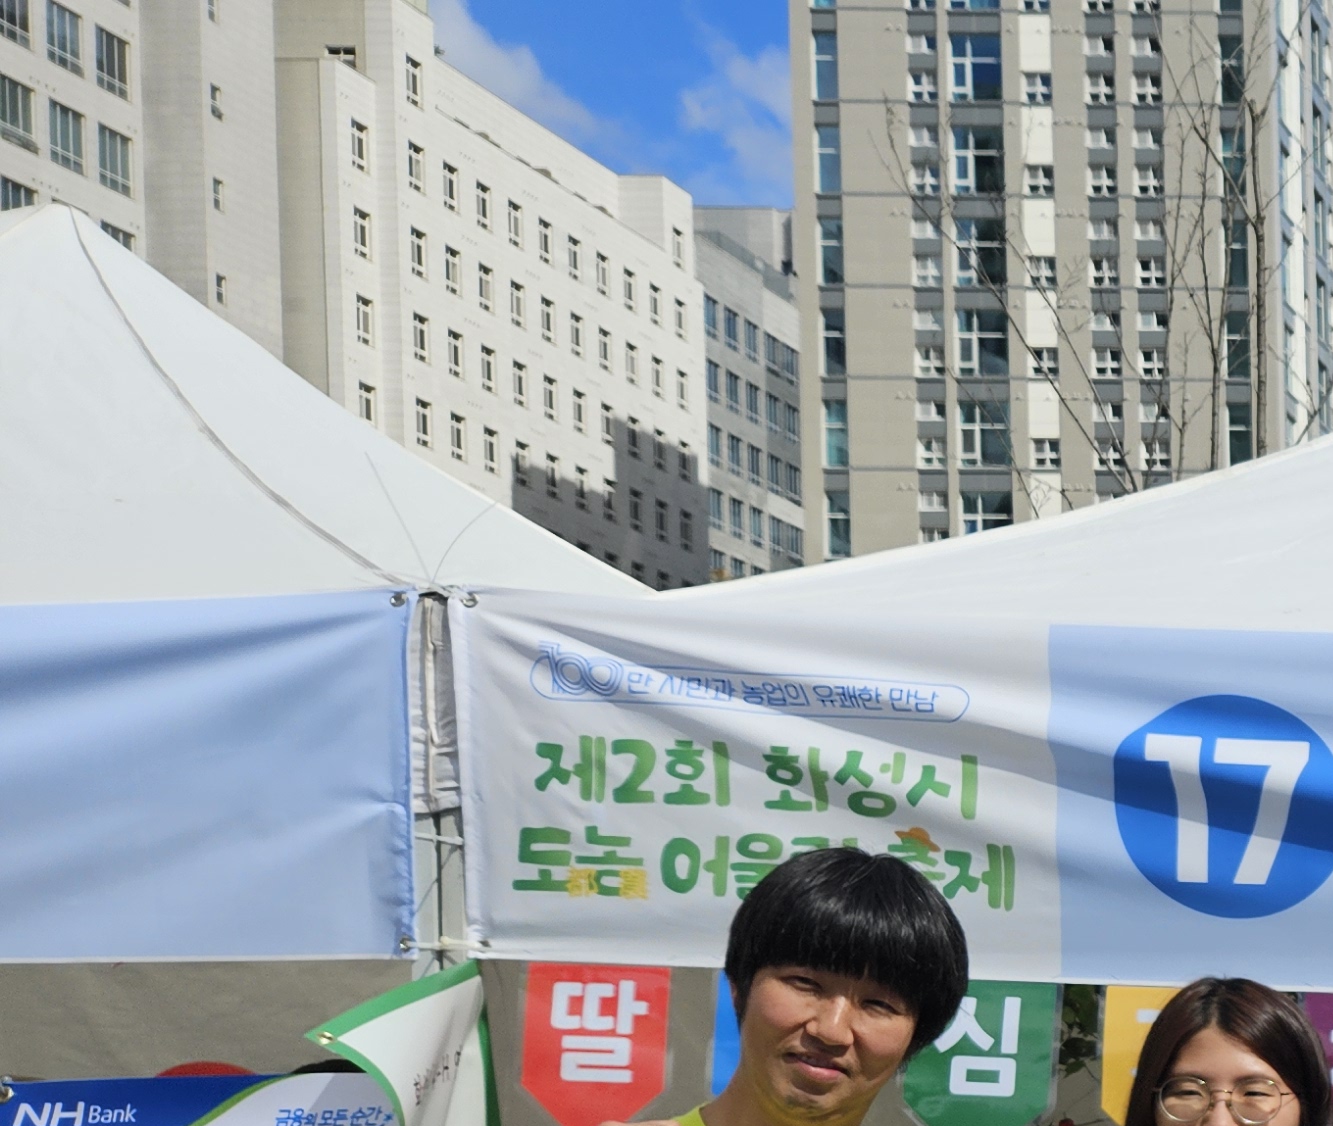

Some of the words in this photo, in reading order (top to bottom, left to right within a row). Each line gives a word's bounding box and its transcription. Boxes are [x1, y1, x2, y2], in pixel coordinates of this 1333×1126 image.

[658, 674, 736, 702] 시민과
[741, 680, 806, 708] 농업의
[812, 683, 883, 711] 유쾌한
[888, 684, 939, 713] 만남
[533, 734, 731, 807] 제2회
[761, 744, 979, 821] 화성시
[1143, 732, 1311, 886] 17
[511, 825, 646, 897] 도농
[549, 980, 650, 1084] 딸
[87, 1103, 138, 1124] Bank
[349, 1105, 383, 1126] 순간
